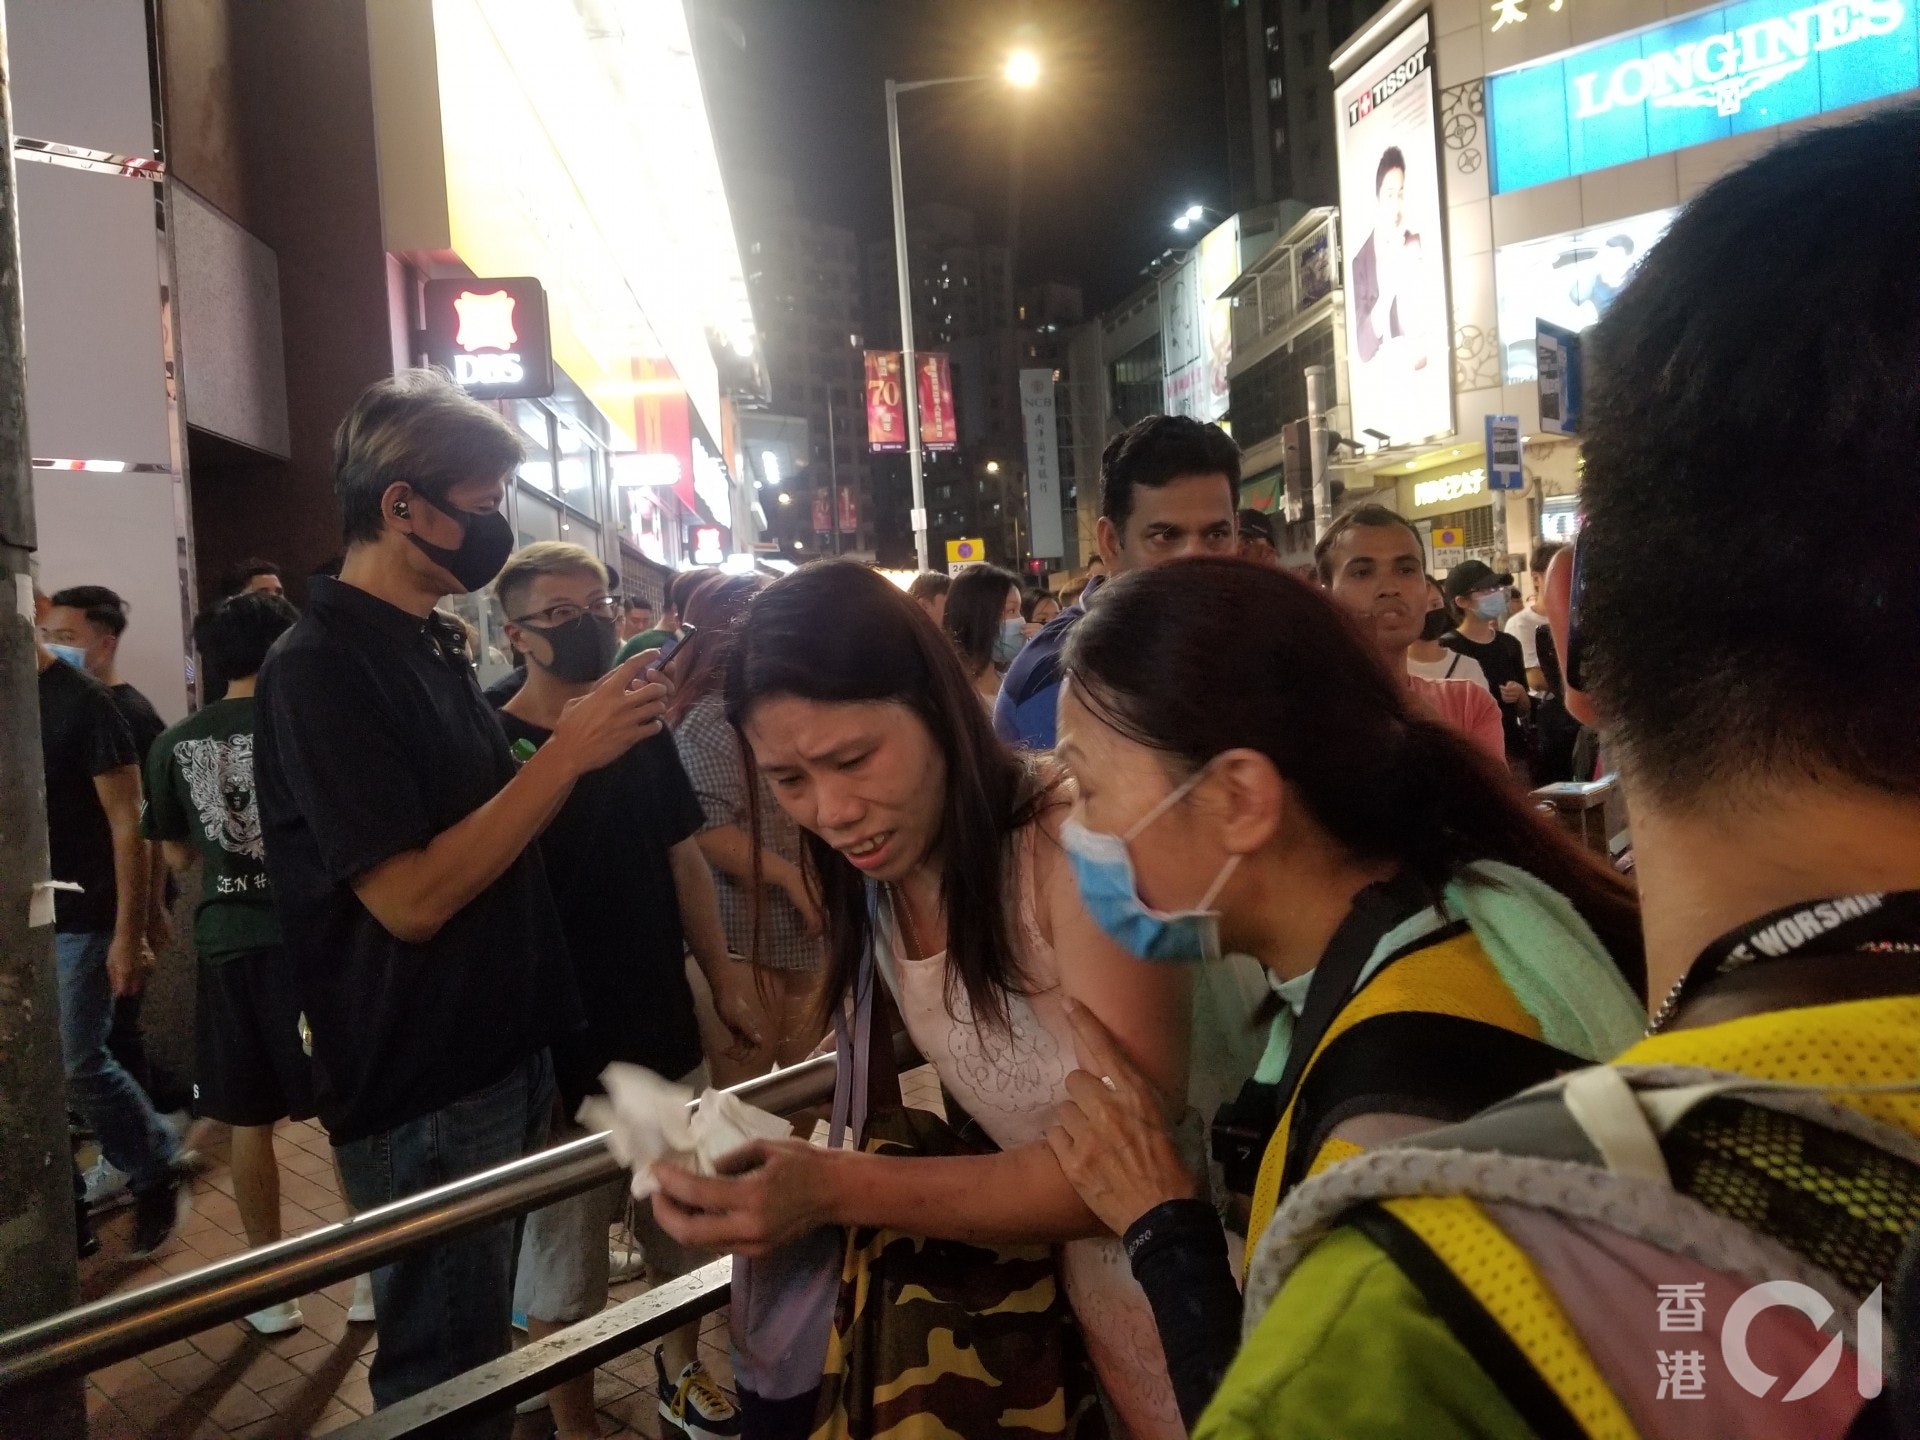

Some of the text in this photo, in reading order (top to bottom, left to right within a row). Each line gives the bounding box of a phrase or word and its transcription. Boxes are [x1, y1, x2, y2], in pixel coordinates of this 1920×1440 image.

[1574, 0, 1905, 118] LONGINES
[1373, 46, 1427, 107] TISSOT
[454, 353, 524, 384] DBS
[868, 380, 900, 406] 70
[1025, 398, 1052, 408] NCB
[952, 564, 964, 573] 24
